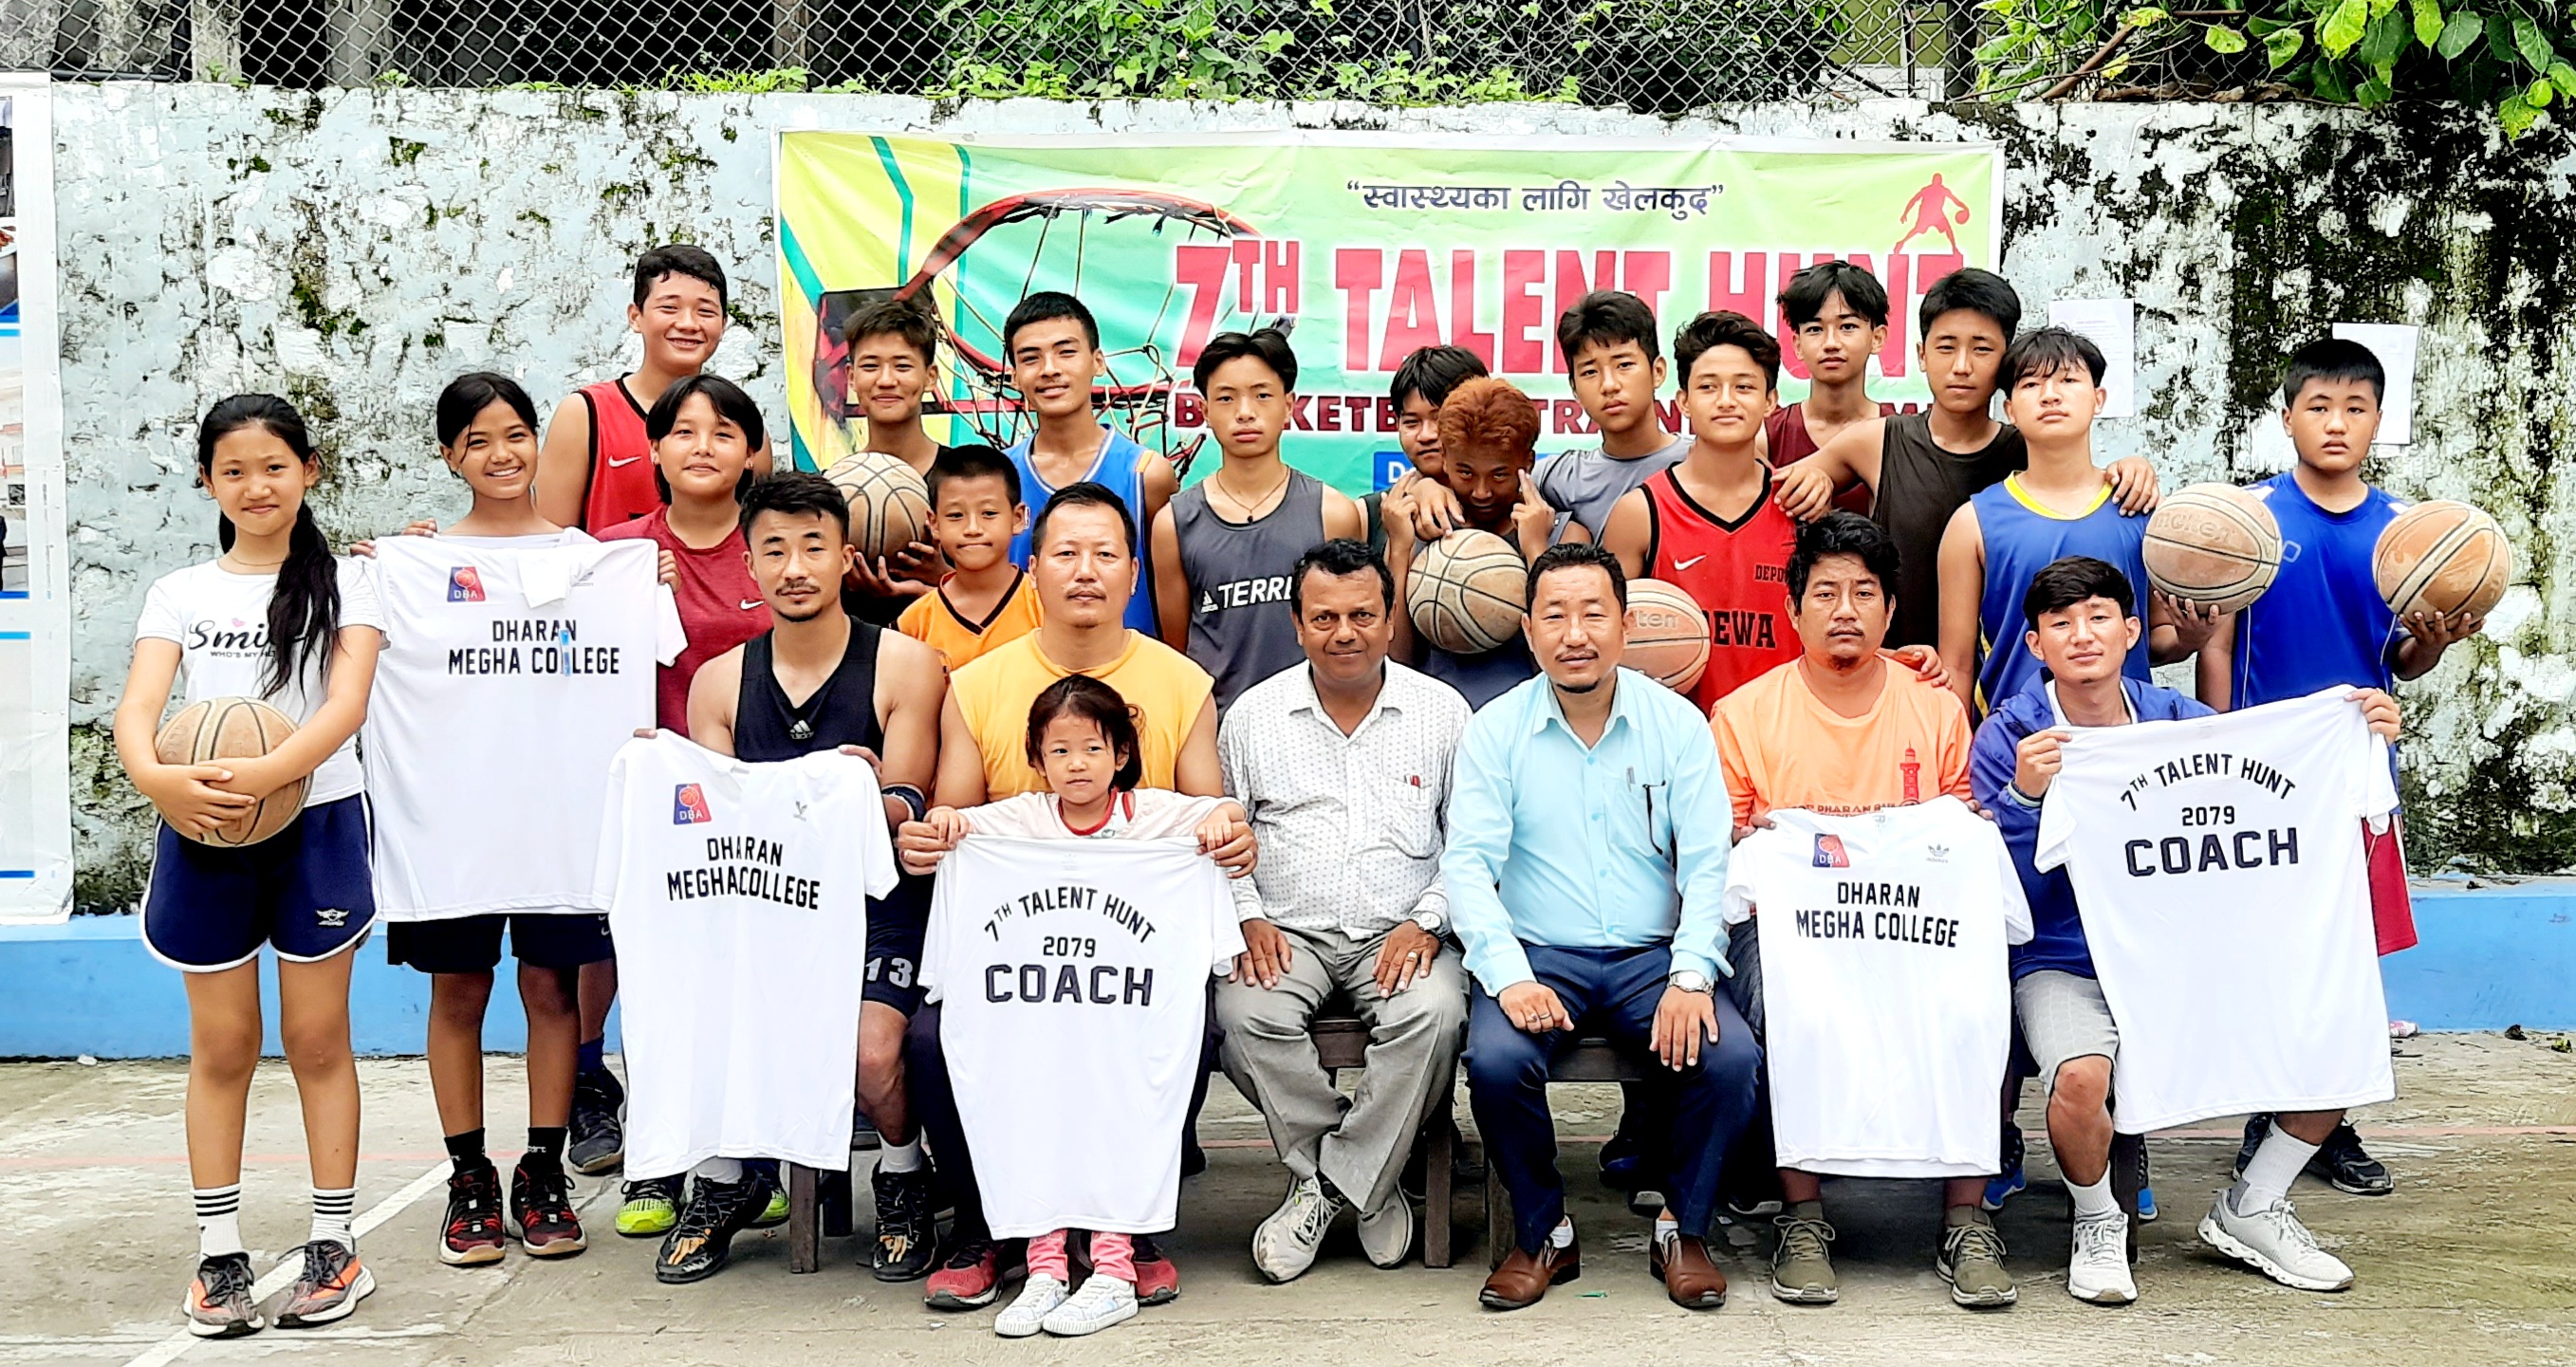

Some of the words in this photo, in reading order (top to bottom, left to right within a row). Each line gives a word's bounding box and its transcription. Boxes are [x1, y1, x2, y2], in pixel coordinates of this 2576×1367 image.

[1521, 179, 1592, 212] लागि
[1176, 240, 1300, 368] 7TH
[453, 589, 479, 600] DBA
[491, 619, 577, 642] DHARAN
[448, 647, 522, 675] MEGHA
[531, 647, 621, 674] COLEGE
[2153, 752, 2233, 787] TALENT
[2240, 757, 2296, 800] HUNT
[679, 809, 704, 822] DBA
[2181, 804, 2235, 827] 2079
[707, 835, 784, 867] DHARAN
[1819, 855, 1843, 865] DBA
[2124, 826, 2299, 877] COACH
[1837, 881, 1920, 909] DHARAN
[1017, 886, 1099, 918] TALENT
[1103, 894, 1157, 944] HUNT
[1795, 909, 1865, 940] MEGHA
[1874, 911, 1960, 948] COLLEGE
[1043, 935, 1097, 958] 2079
[864, 956, 914, 988] 13
[985, 963, 1154, 1007] COACH
